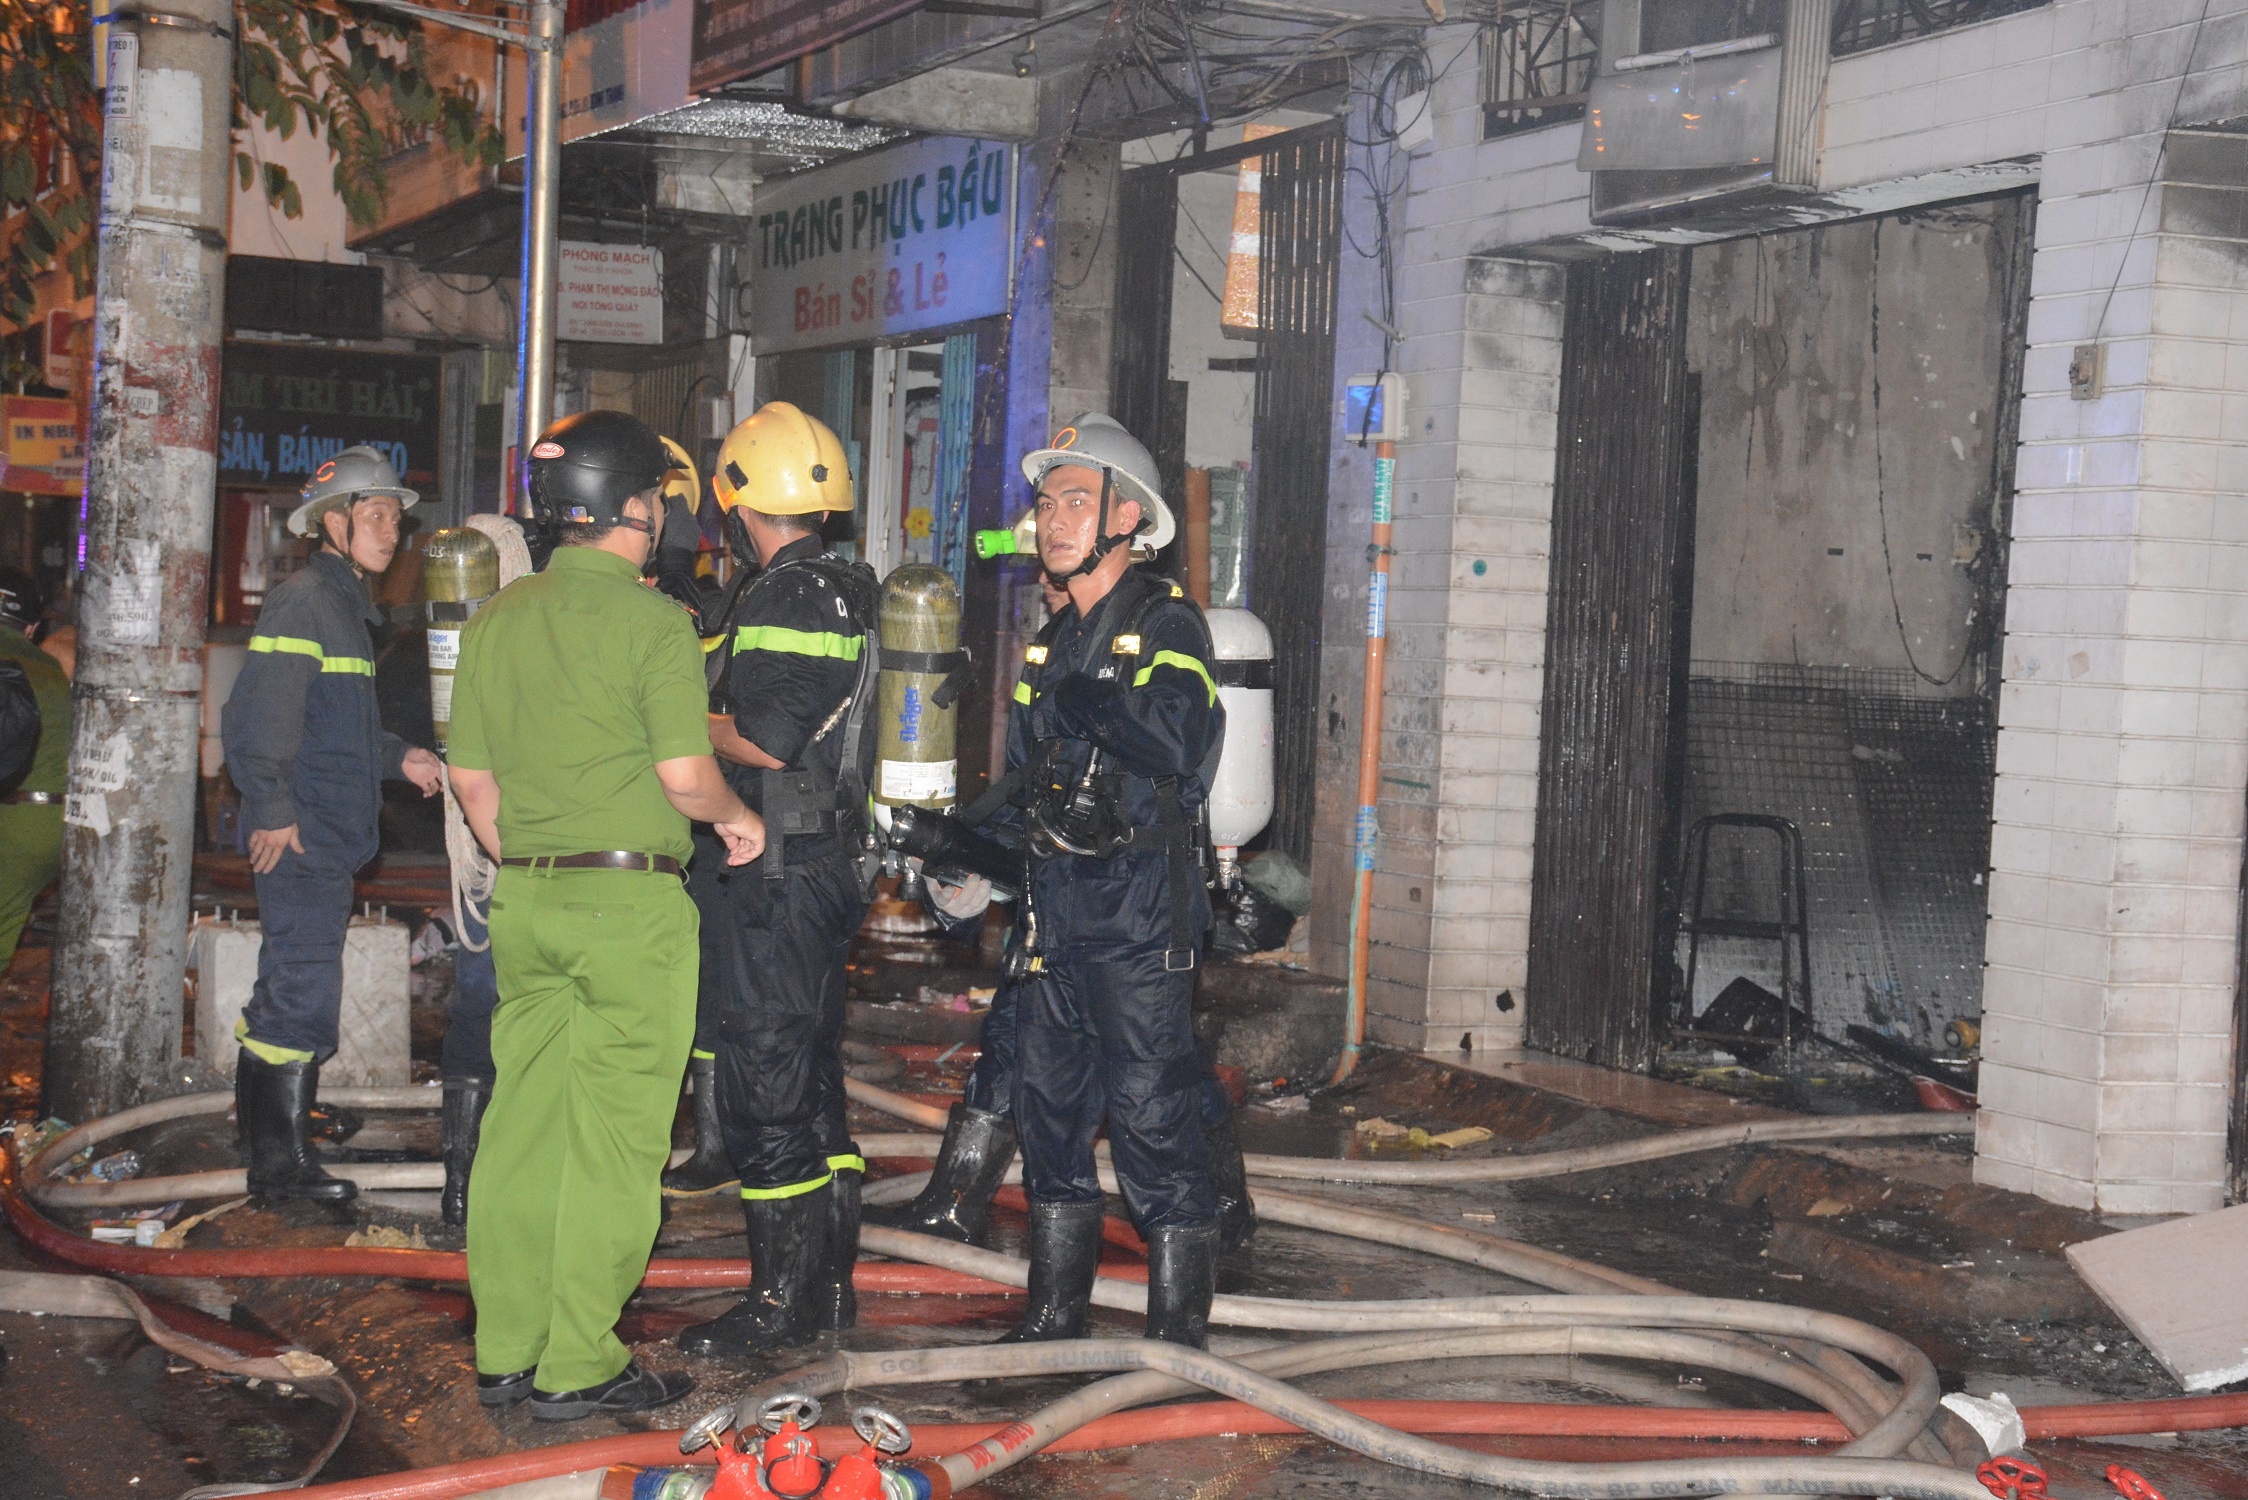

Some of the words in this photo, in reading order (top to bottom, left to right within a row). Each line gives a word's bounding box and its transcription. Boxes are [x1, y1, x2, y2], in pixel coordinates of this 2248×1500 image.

[758, 196, 843, 270] TRANG
[852, 173, 926, 256] PHỤC
[794, 283, 842, 333] Bán
[852, 269, 877, 325] Sỉ
[884, 267, 905, 318] &
[914, 252, 949, 313] Lẻ
[900, 686, 922, 742] Dräger
[1763, 1479, 1836, 1493] MADE
